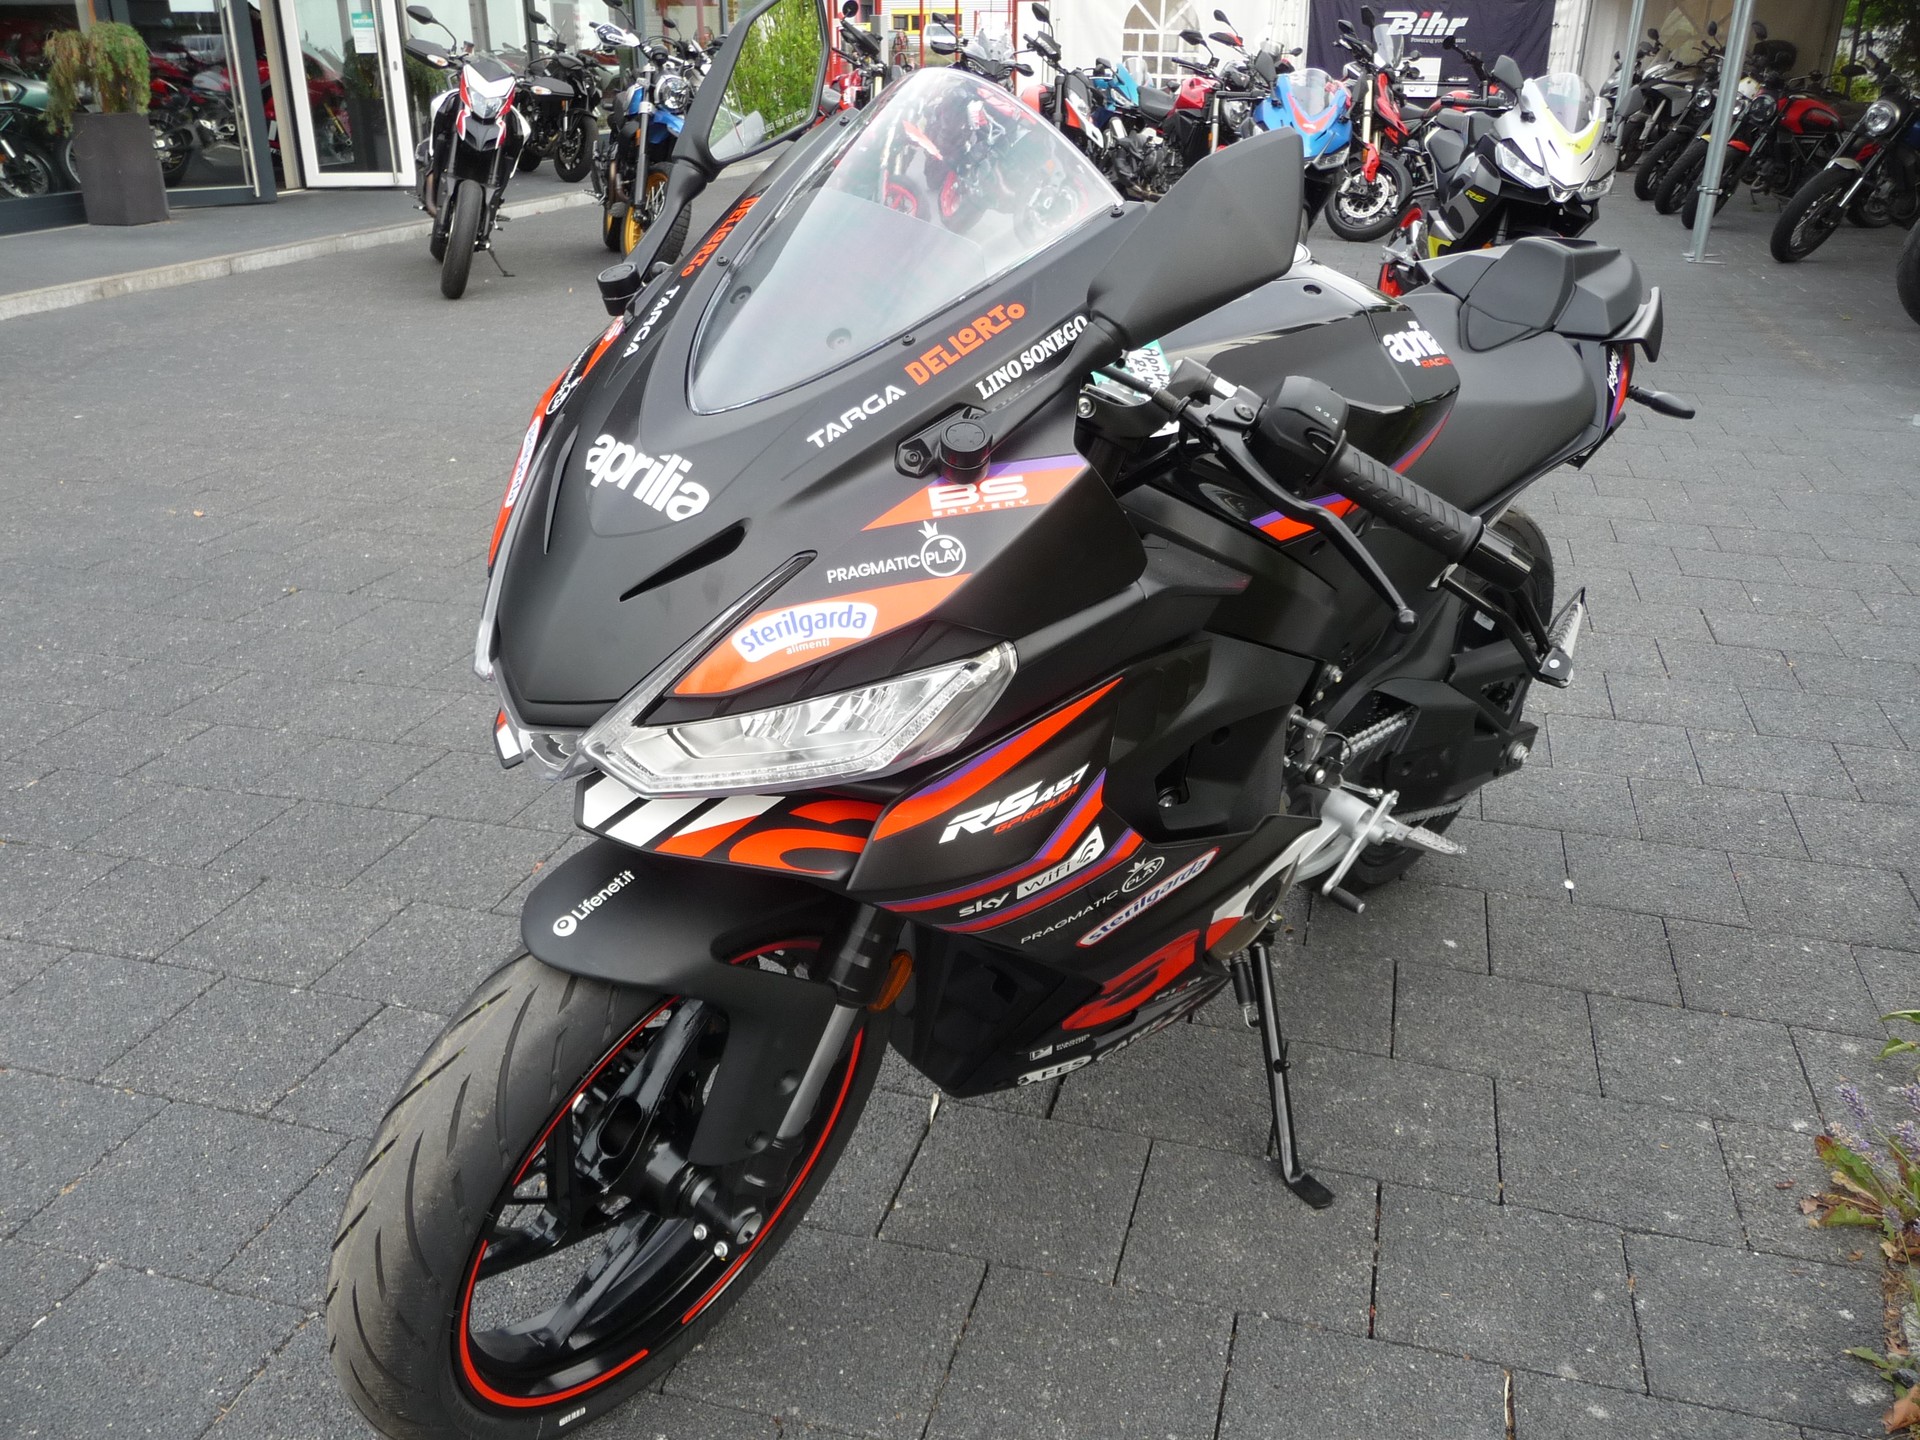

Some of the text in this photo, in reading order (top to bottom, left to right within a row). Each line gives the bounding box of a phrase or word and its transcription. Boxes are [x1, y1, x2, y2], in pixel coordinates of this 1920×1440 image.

[1383, 11, 1469, 36] Bihr
[622, 284, 681, 358] TARGA
[975, 314, 1089, 400] LINO SONEGO
[806, 384, 907, 449] TARGA
[585, 433, 710, 522] aprilia
[928, 475, 1028, 511] BS
[932, 499, 1030, 517] BATTERY
[826, 547, 962, 584] PRAGMATIC PLAY
[740, 604, 868, 652] sterilgarda
[786, 637, 831, 655] alimenti
[993, 784, 1080, 835] GP REPLICA
[571, 869, 636, 921] Lifenet.it
[959, 861, 1071, 918] sky wifi
[1021, 889, 1119, 945] PRAGMATIC
[1126, 860, 1162, 891] PLAY
[1089, 857, 1207, 941] sterilgarda
